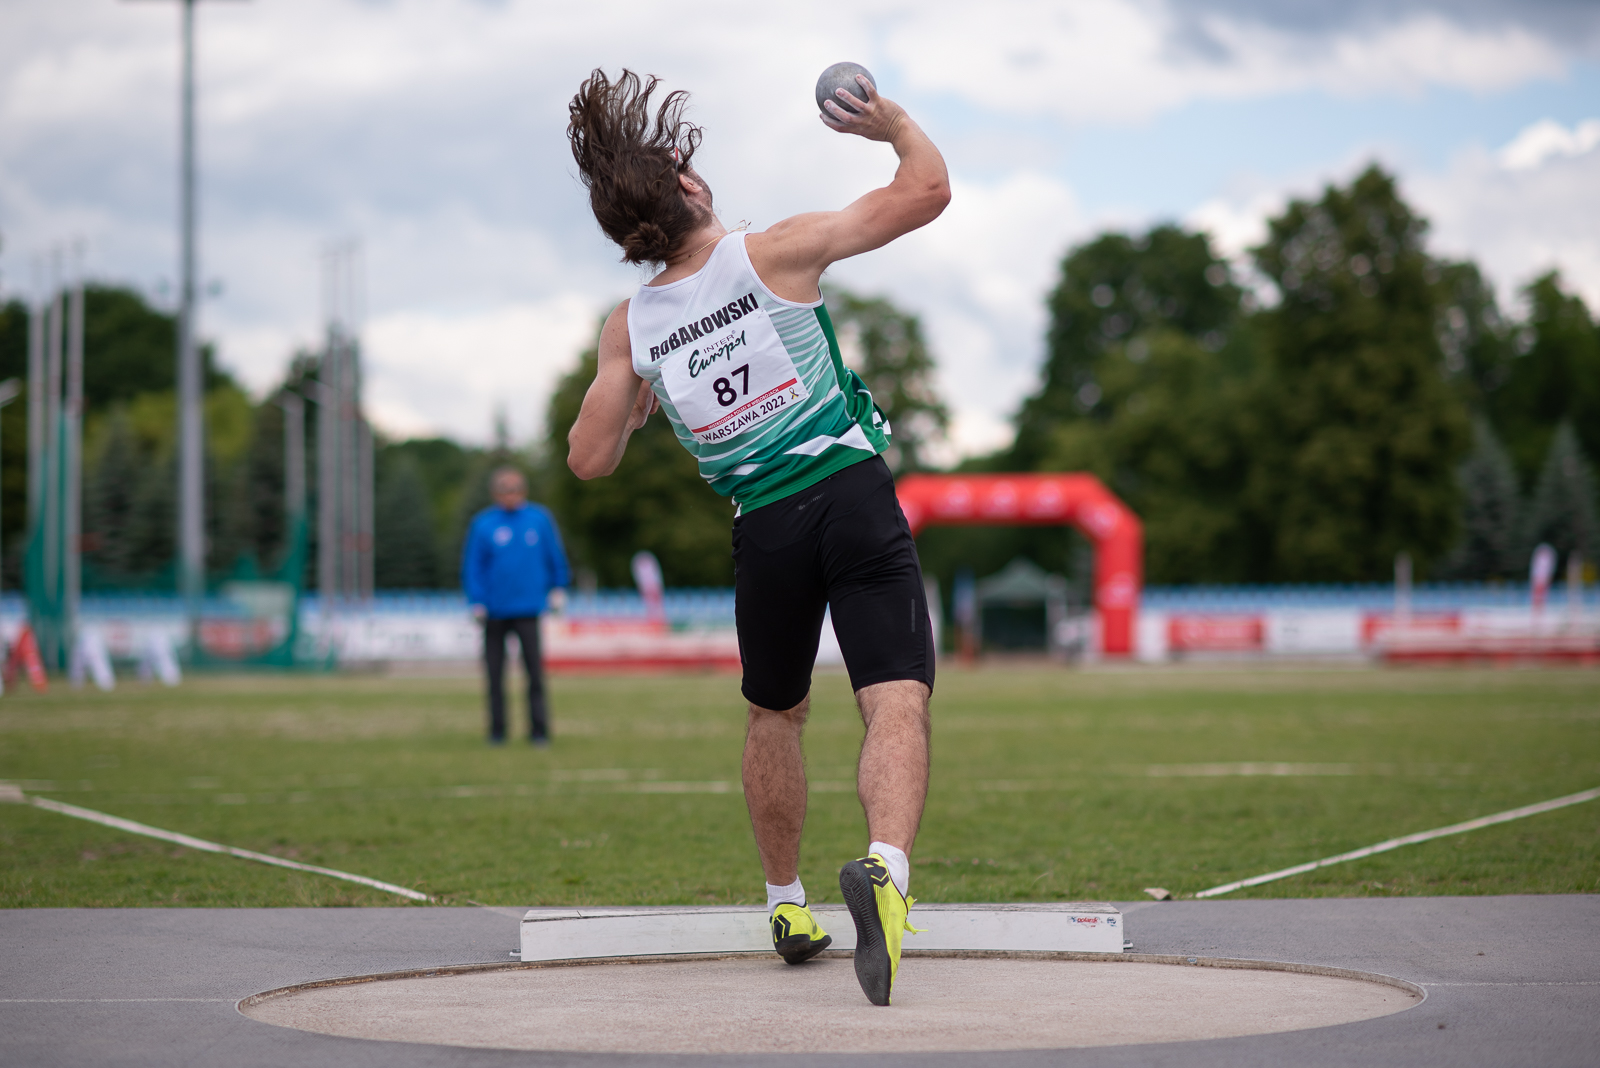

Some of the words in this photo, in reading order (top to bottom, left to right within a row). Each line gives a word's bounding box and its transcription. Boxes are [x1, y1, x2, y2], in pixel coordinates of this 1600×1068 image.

[649, 292, 759, 362] ROBAKOWSKI
[703, 333, 735, 354] INTER
[688, 330, 747, 378] Europol
[712, 363, 749, 407] 87
[701, 409, 760, 442] WARSZAWA
[760, 395, 787, 417] 2022
